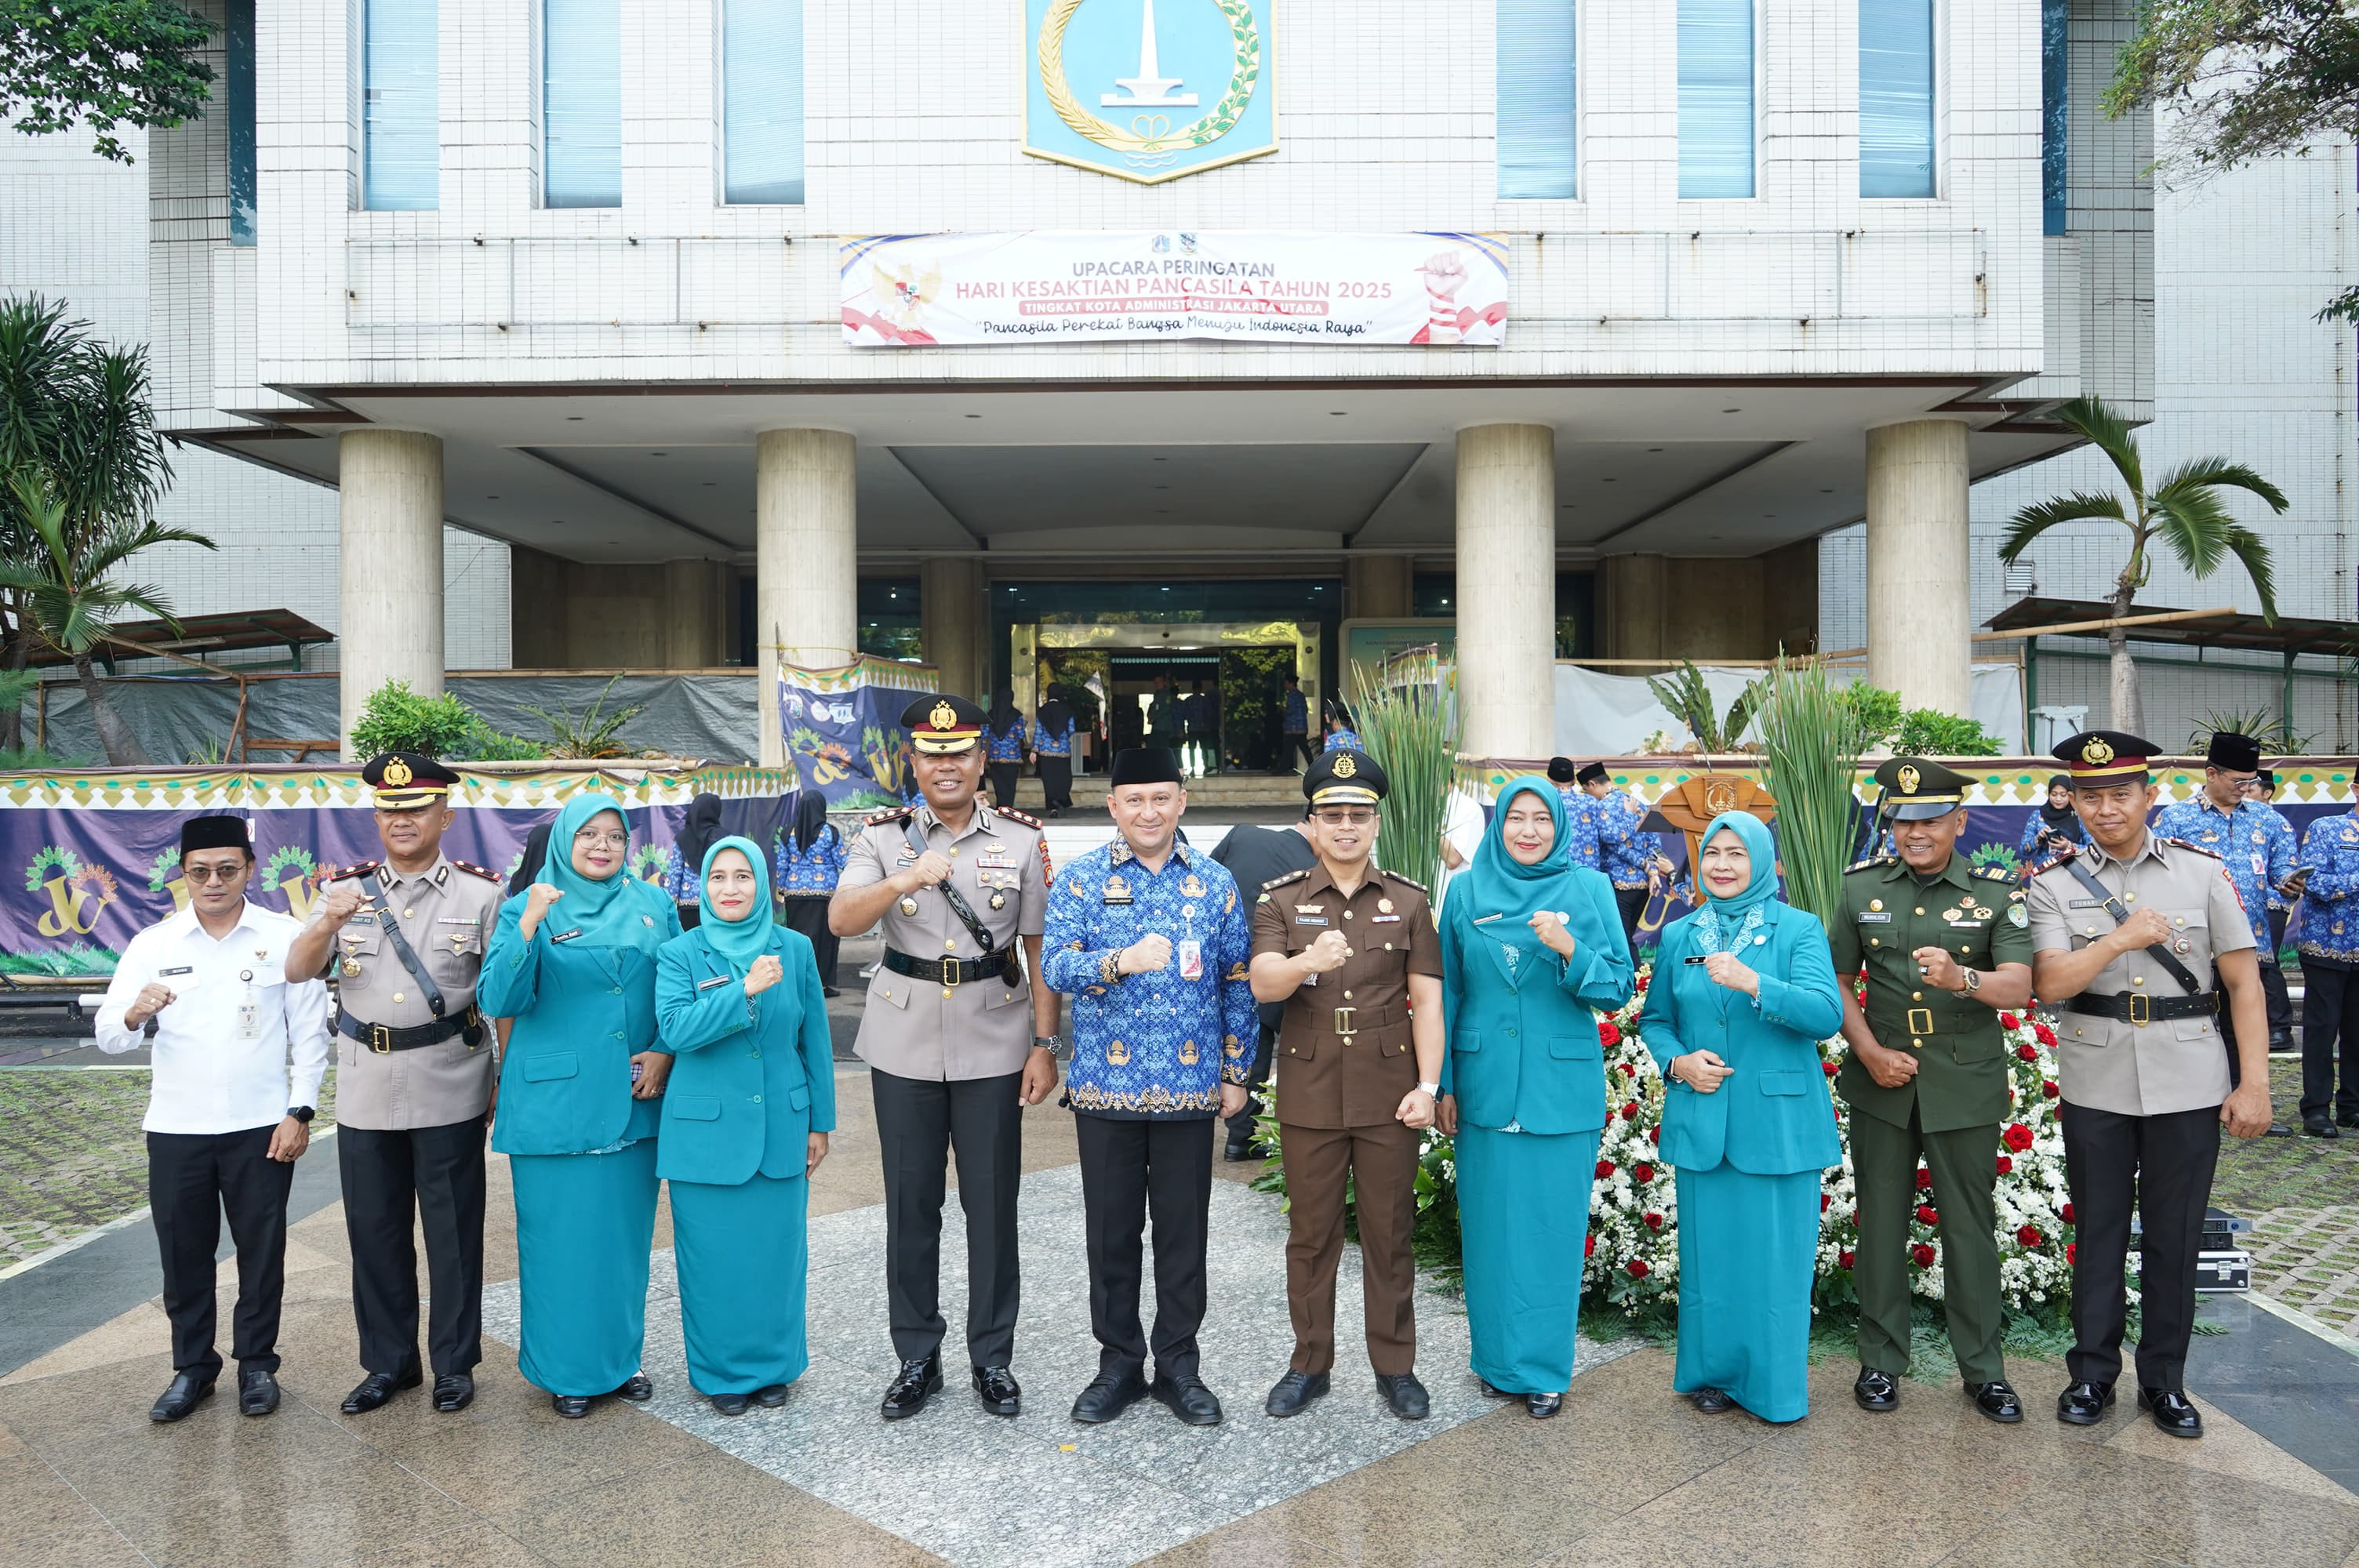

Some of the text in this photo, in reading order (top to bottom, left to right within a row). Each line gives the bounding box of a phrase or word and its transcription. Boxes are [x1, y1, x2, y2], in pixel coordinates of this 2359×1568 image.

[1073, 260, 1274, 277] UPACARA PERINGATAN
[956, 277, 1391, 299] HARI KESAKTIAN PANCASILA TAHUN 2025
[1025, 299, 1322, 314] TINGKAT KOTA ADMINISTRASI JAKARTA UTARA
[1063, 318, 1123, 332] Perekat
[1128, 317, 1183, 332] Bangsa
[1187, 315, 1245, 332] Menuju
[1249, 318, 1321, 332] Indonesia
